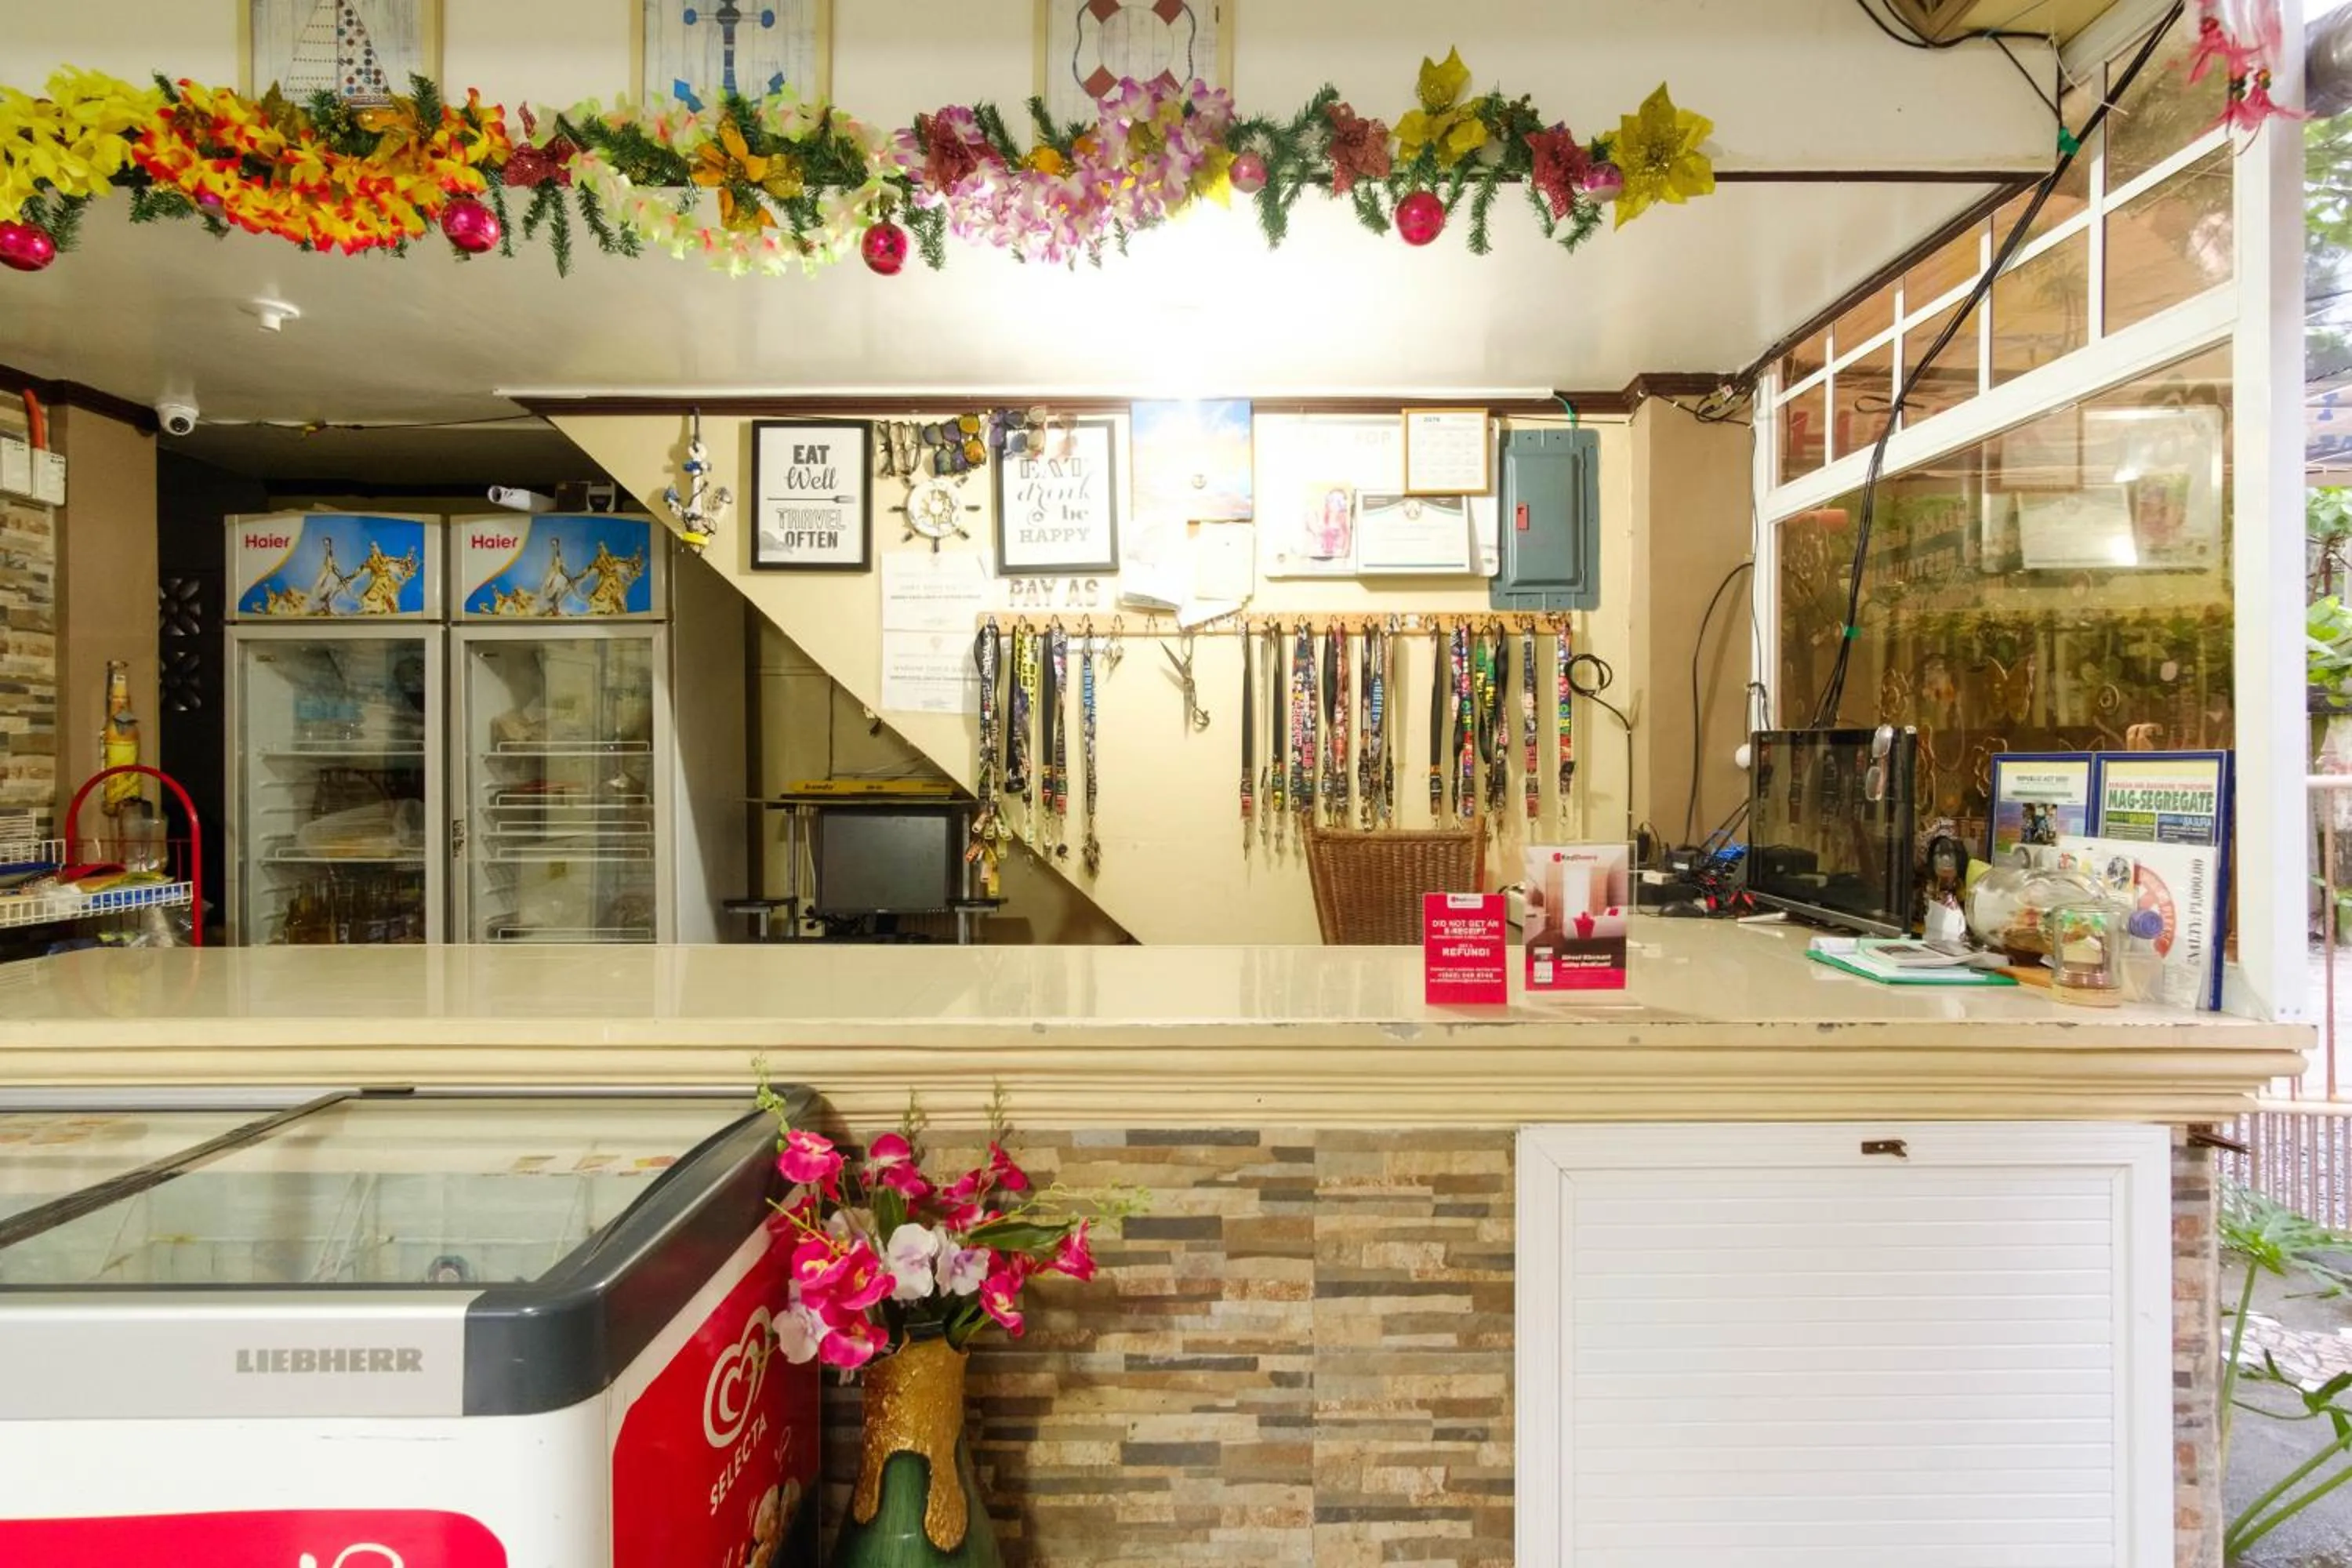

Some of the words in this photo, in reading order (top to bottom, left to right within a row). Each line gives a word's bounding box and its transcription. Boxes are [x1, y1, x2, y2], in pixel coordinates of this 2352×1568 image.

[793, 445, 830, 464] EAT
[784, 466, 839, 490] Well
[776, 508, 846, 531] TRAVEL
[245, 533, 292, 550] Haier
[471, 535, 519, 550] Haier
[785, 531, 838, 548] OFTEN
[1019, 528, 1091, 544] HAPPY
[2108, 789, 2214, 812] MAG-SEGREGATE
[1442, 948, 1490, 956] REFUND!
[236, 1348, 424, 1373] LIEBHERR
[710, 1412, 768, 1516] SELECTA
